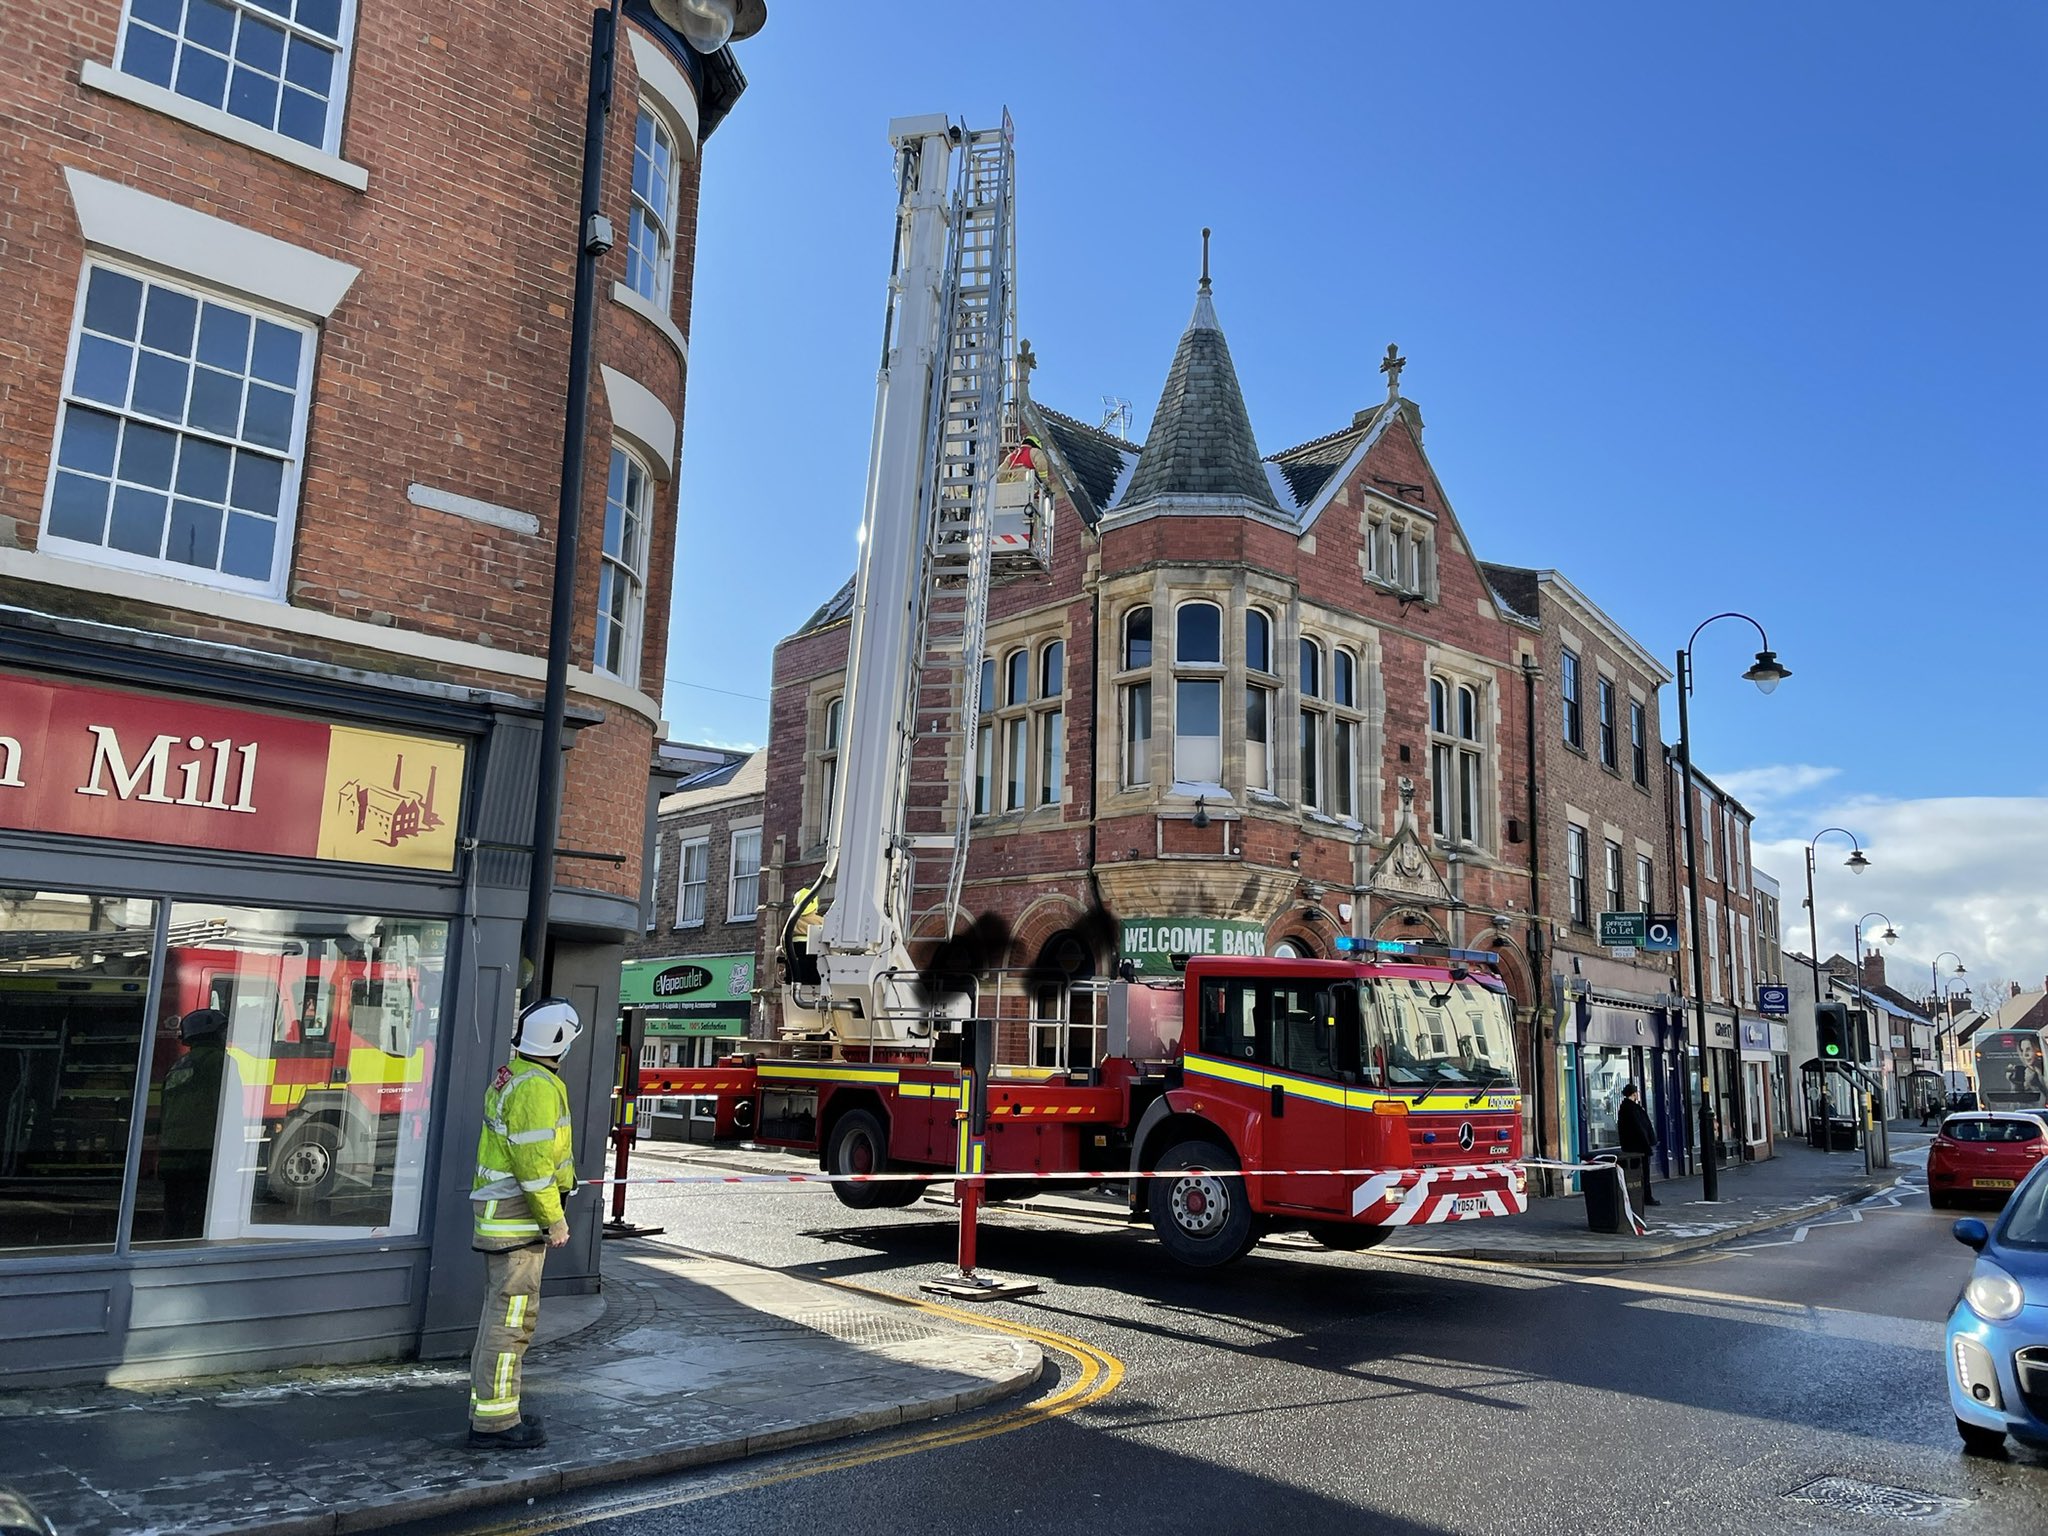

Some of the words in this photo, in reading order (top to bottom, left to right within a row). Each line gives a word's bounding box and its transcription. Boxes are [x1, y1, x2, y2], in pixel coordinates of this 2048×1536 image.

[973, 652, 982, 709] YORKSHIRE
[981, 563, 989, 603] RESCUE
[77, 725, 258, 813] Mill
[1124, 926, 1216, 953] WELCOME
[1222, 929, 1265, 956] BACK
[1604, 926, 1617, 935] To
[1619, 926, 1635, 935] Let
[1649, 924, 1673, 946] O2
[655, 968, 703, 995] eVapeoutlet
[700, 1020, 727, 1030] Satisfaction
[1457, 1199, 1474, 1212] YD52
